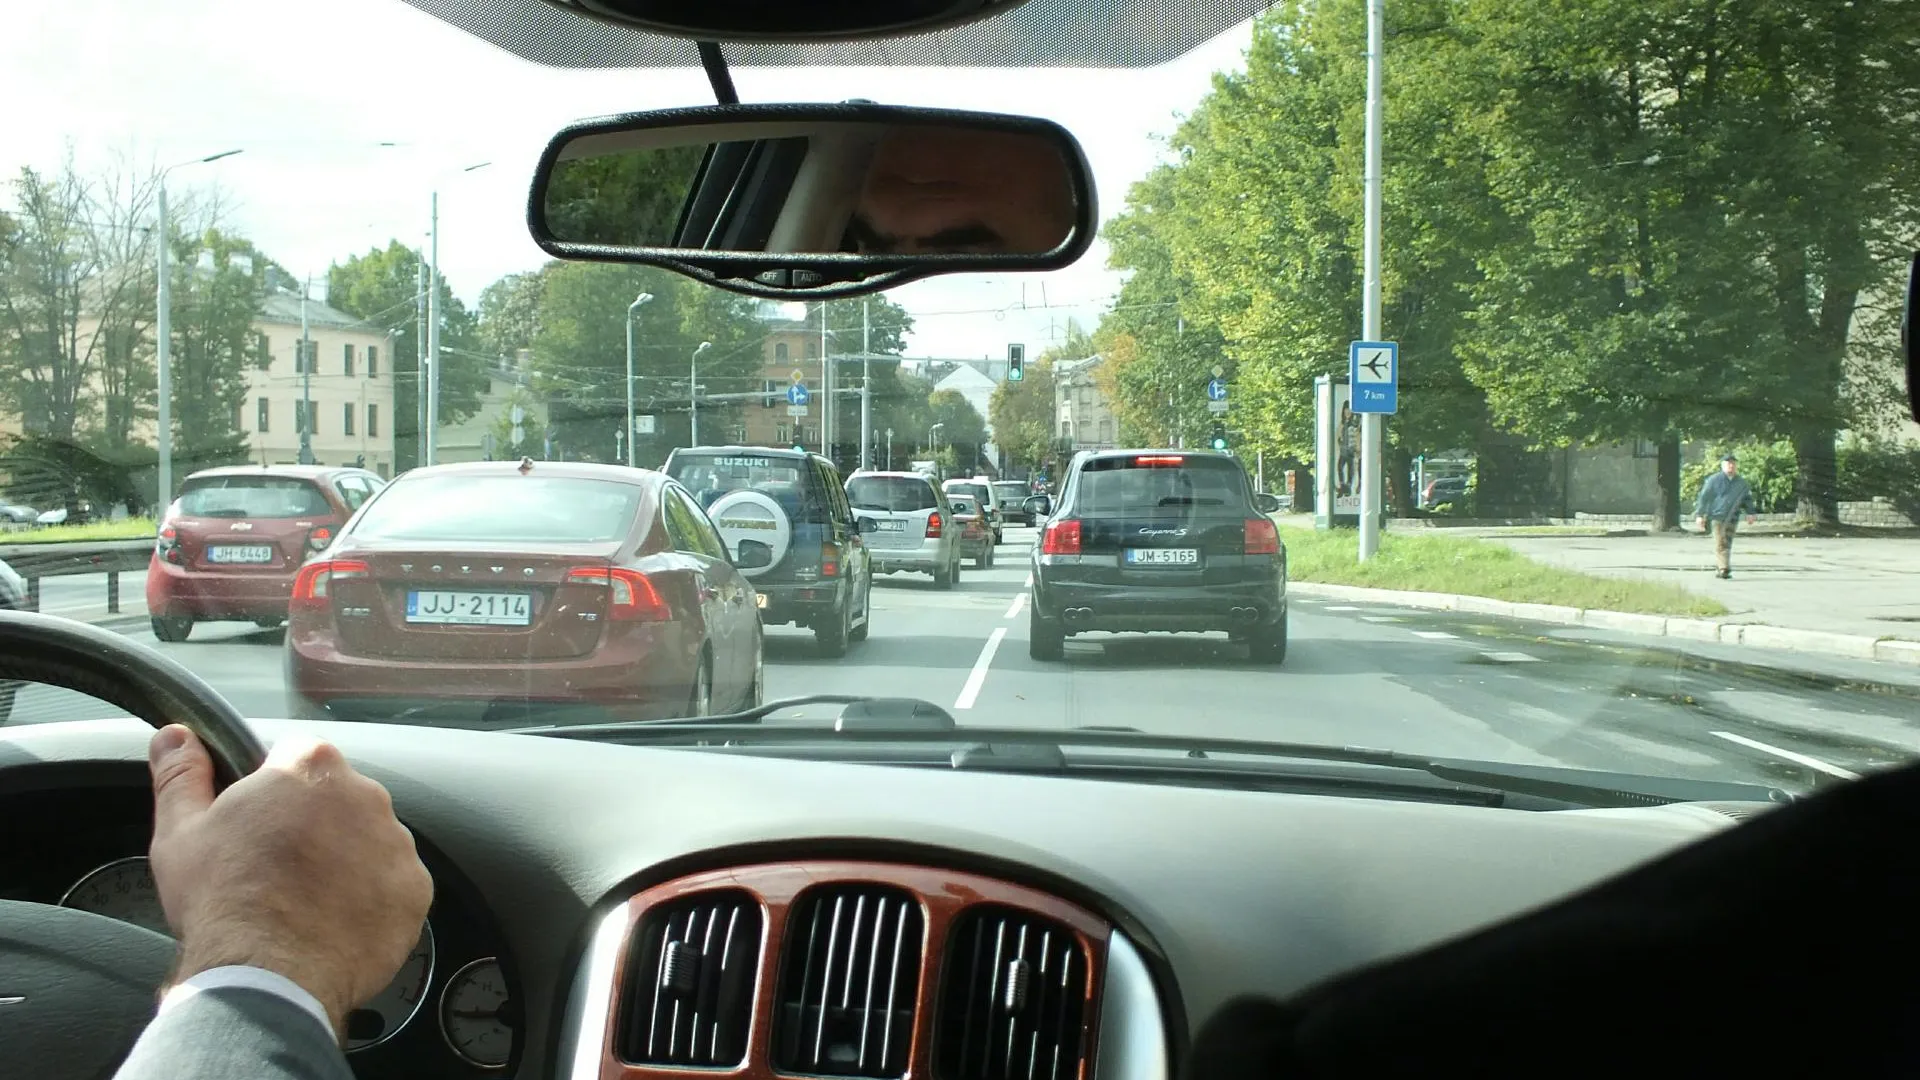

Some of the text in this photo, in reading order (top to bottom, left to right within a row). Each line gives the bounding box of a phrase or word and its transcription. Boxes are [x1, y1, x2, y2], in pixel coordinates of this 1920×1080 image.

[762, 271, 777, 281] OFF
[800, 272, 823, 282] AUTO
[1364, 389, 1385, 400] 7 km
[713, 457, 769, 467] SUZUKI
[1336, 497, 1360, 507] LIND
[1175, 528, 1188, 536] S
[1137, 550, 1195, 562] JM-5165
[400, 564, 534, 576] VOLVO
[424, 594, 525, 616] JJ-2114
